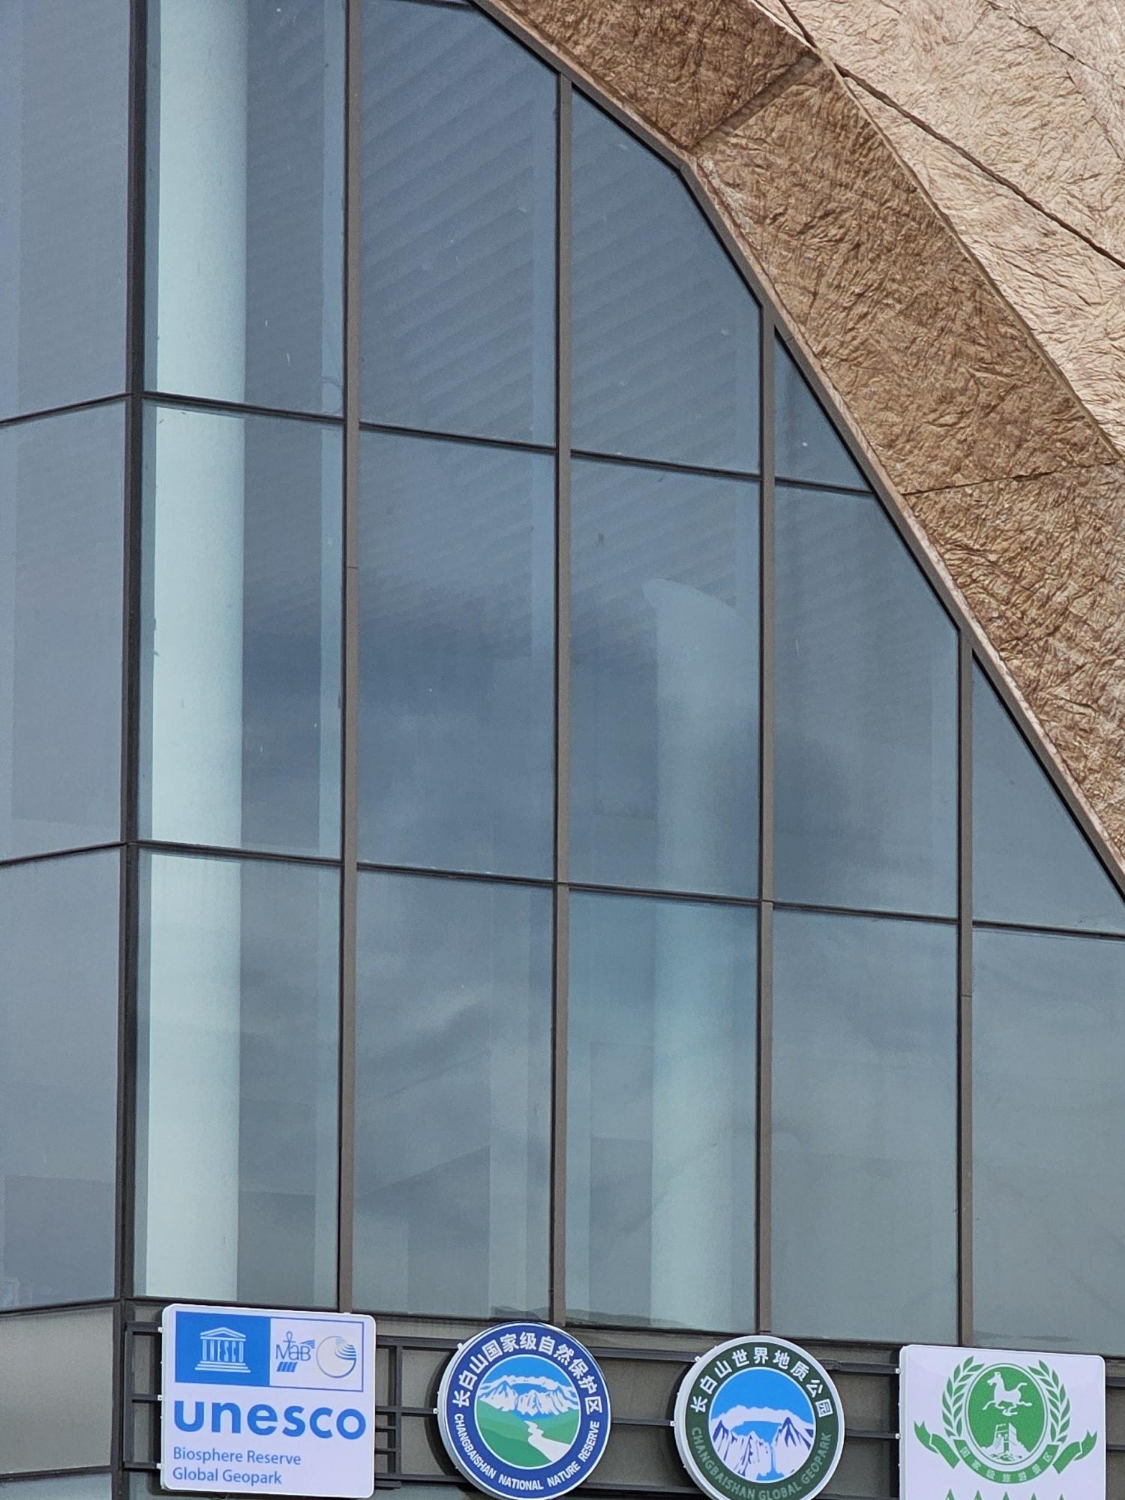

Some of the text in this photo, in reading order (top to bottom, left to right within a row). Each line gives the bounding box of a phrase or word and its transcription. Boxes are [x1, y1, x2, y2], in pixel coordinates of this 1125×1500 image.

[202, 1339, 244, 1363] UNESCO
[452, 1331, 603, 1416] 长白山国家级自然保护区
[690, 1346, 834, 1418] 长白山世界地质公园
[174, 1400, 367, 1440] unesco
[172, 1466, 282, 1486] Global Geopark
[173, 1446, 302, 1465] Biosphere Reserve
[454, 1413, 600, 1491] CHANGBAISHAN NATIONAL NATURE RESERVE
[691, 1427, 832, 1500] CHANGBAISHAN GLOBAL GEOPARK
